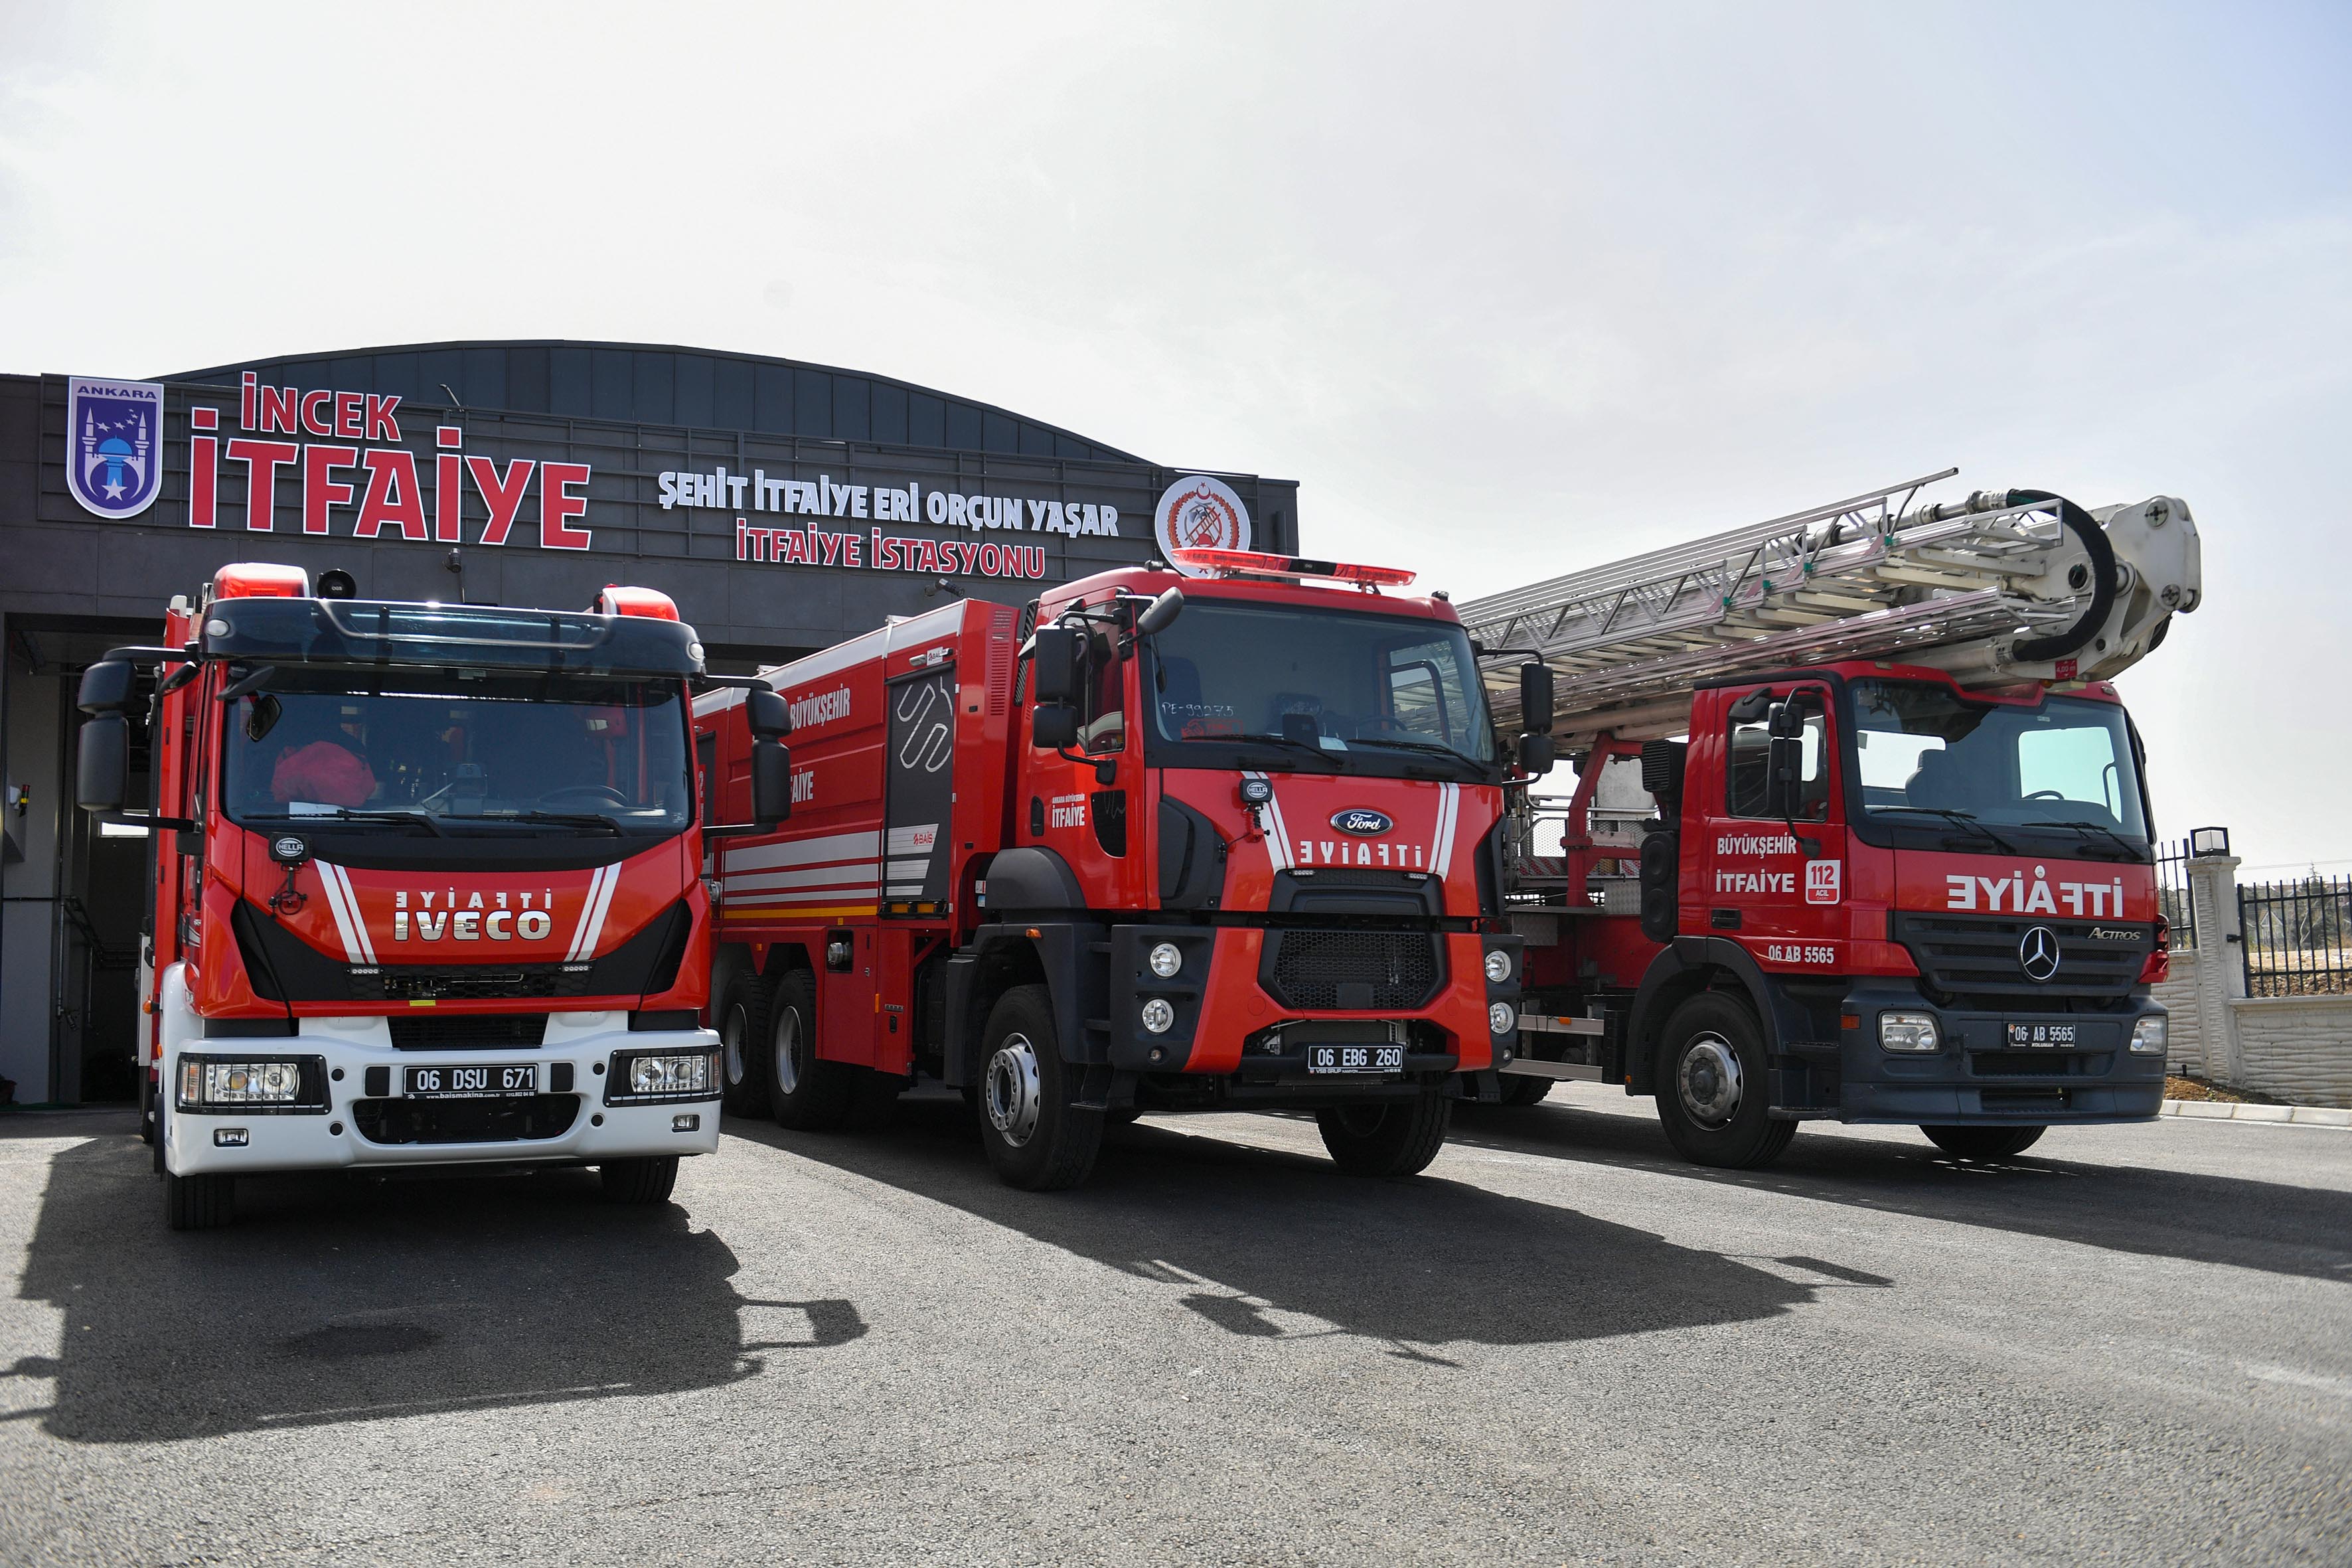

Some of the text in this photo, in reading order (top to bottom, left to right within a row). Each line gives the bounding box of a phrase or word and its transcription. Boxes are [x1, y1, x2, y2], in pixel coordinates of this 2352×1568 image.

[78, 386, 157, 399] ANKARA
[240, 371, 403, 441] İNCEK
[189, 407, 592, 550] İTFAİYE
[658, 466, 1119, 538] ŞEHİT İTFAİYE ERİ ORÇUN YAŞAR
[736, 518, 1046, 580] İTFAİYE İSTASYONU
[790, 683, 850, 730] BÜYÜKŞEHİR
[1052, 803, 1085, 828] İTFAİYE
[1347, 813, 1381, 829] Ford
[1717, 832, 1796, 859] BÜYÜKŞEHİR
[1716, 869, 1795, 892] İTFAİYE
[1811, 865, 1834, 885] 112
[394, 911, 552, 941] IVECO
[1768, 945, 1834, 963] 06 AB 5565
[2015, 1026, 2073, 1041] 06 AB 5565
[1318, 1049, 1401, 1066] 06 EBG 260
[417, 1068, 534, 1091] 06 DSU 671
